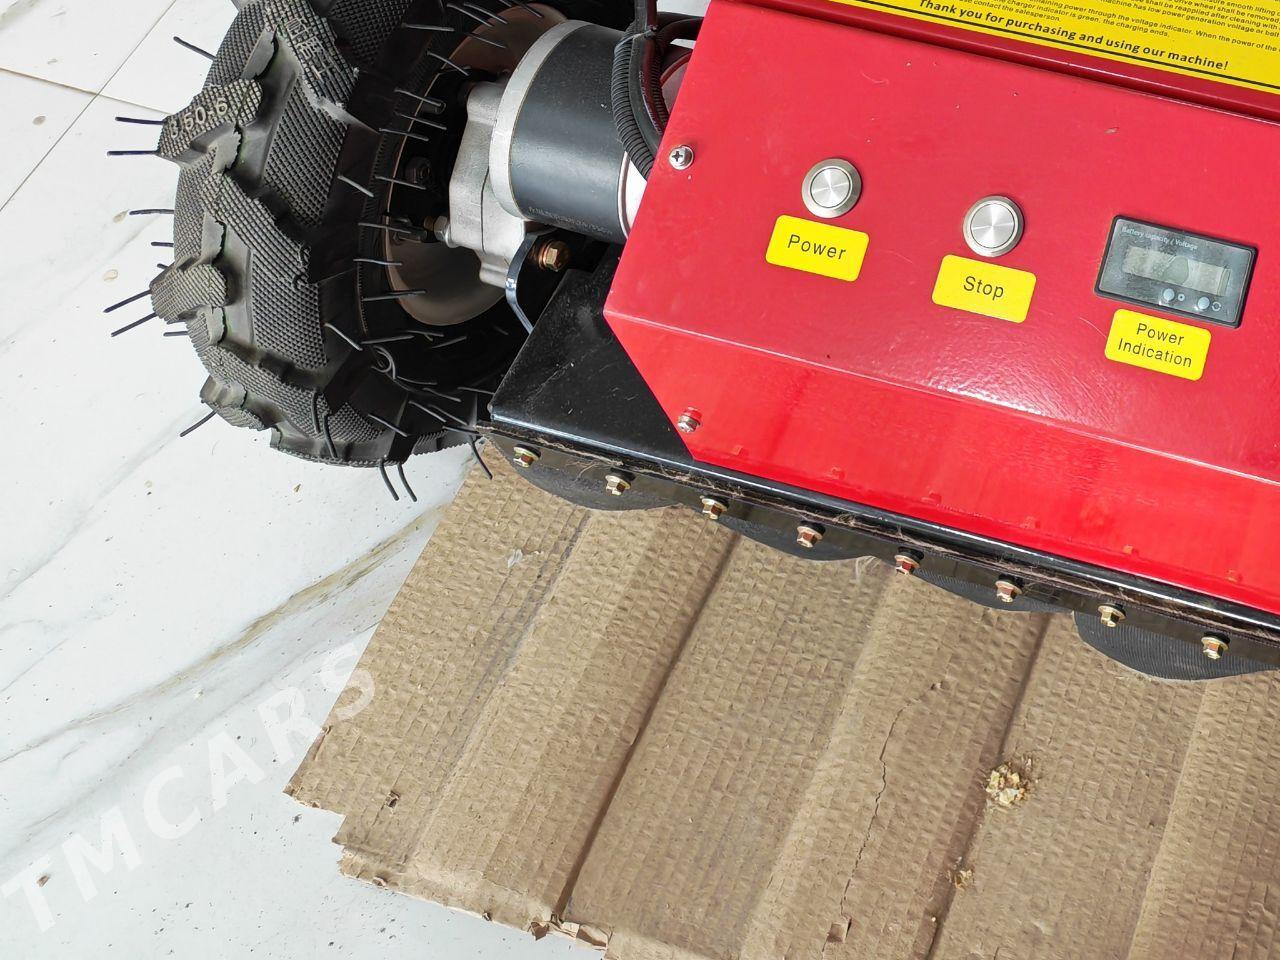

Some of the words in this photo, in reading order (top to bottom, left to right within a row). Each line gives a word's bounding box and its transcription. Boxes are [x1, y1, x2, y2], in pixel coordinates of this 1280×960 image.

[957, 8, 983, 21] you
[983, 11, 1005, 24] for
[1004, 16, 1078, 40] purchasing
[1077, 31, 1104, 44] and
[1103, 36, 1141, 53] using
[1141, 46, 1164, 57] our
[1166, 49, 1229, 70] machine!
[787, 234, 846, 261] Power
[1175, 238, 1198, 251] Voltage
[963, 274, 1005, 300] Stop
[1136, 322, 1185, 346] Power
[1118, 337, 1192, 368] Indication
